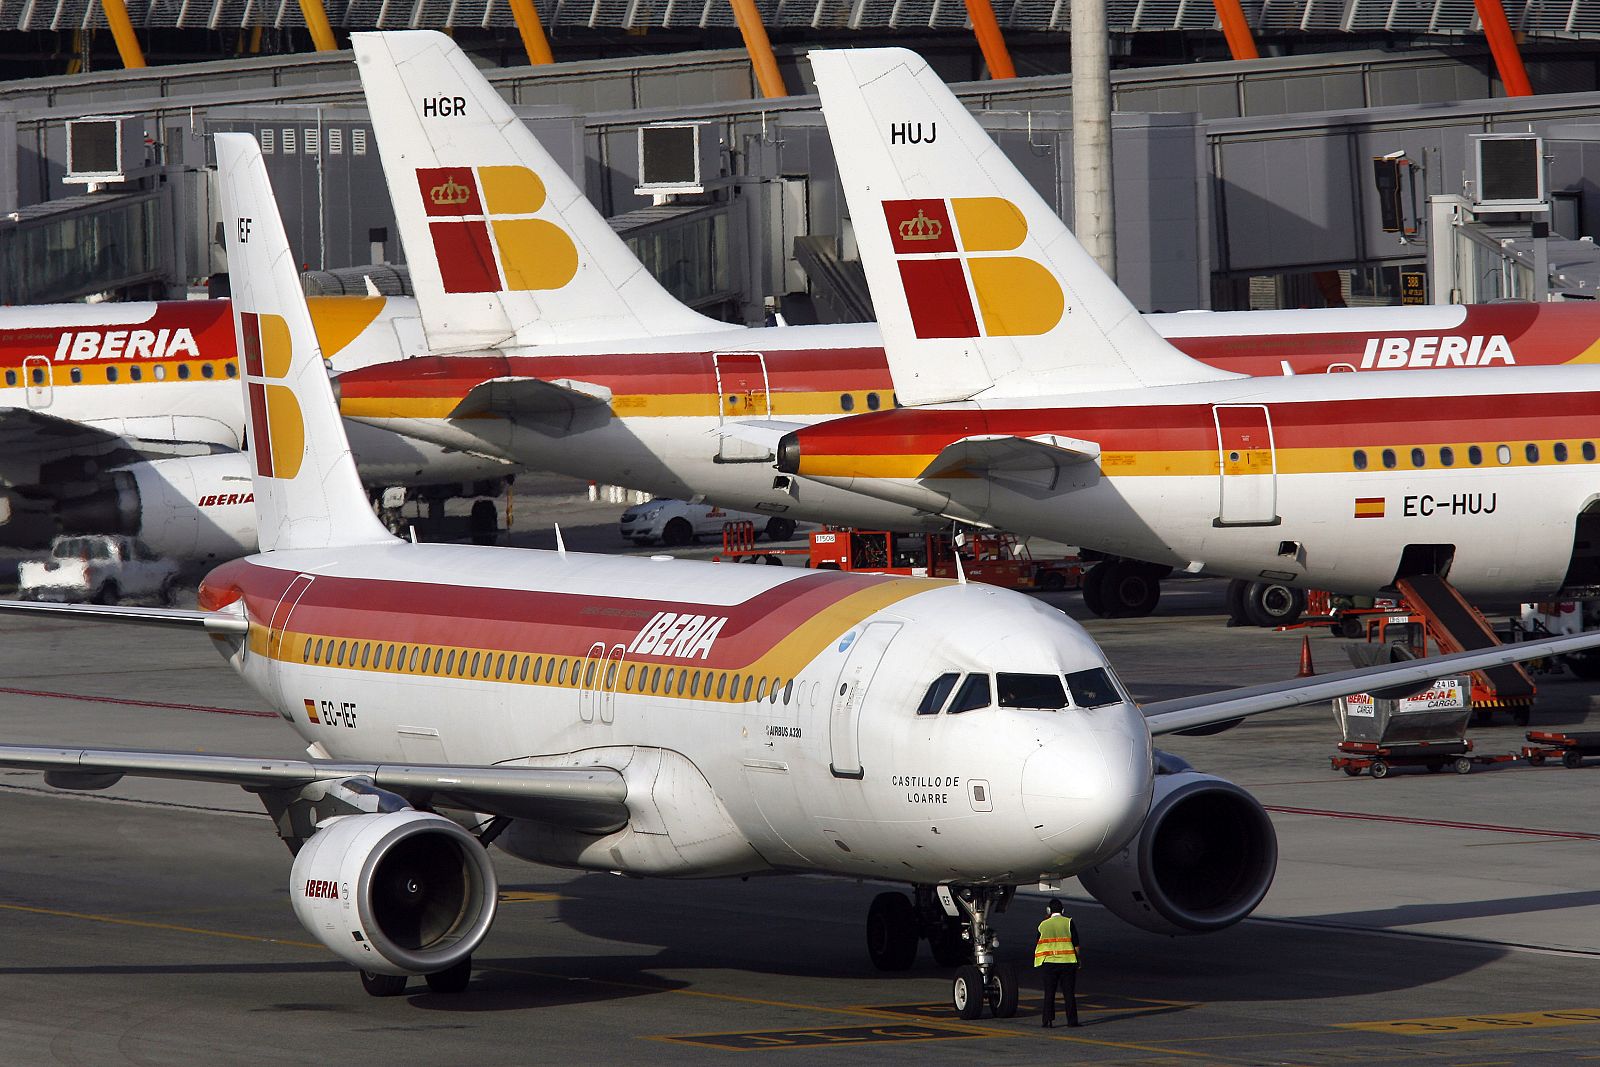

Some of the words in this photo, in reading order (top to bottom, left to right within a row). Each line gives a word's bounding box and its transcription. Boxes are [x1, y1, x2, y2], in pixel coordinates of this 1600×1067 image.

[423, 96, 466, 118] HGR
[891, 122, 936, 145] HUJ
[237, 217, 252, 243] IEF
[54, 327, 200, 361] IBERIA
[1360, 334, 1516, 369] IBERIA
[198, 493, 254, 507] IBERIA
[1403, 492, 1497, 517] EC-HUJ
[626, 611, 729, 660] IBERIA
[321, 700, 357, 728] EC-IEF
[1356, 705, 1373, 714] CARGO
[1427, 699, 1457, 708] CARGO
[769, 725, 788, 737] AIRBUS
[892, 775, 942, 787] CASTILLO
[945, 776, 960, 787] DE
[907, 792, 948, 804] LOARRE
[304, 879, 339, 899] IBERIA
